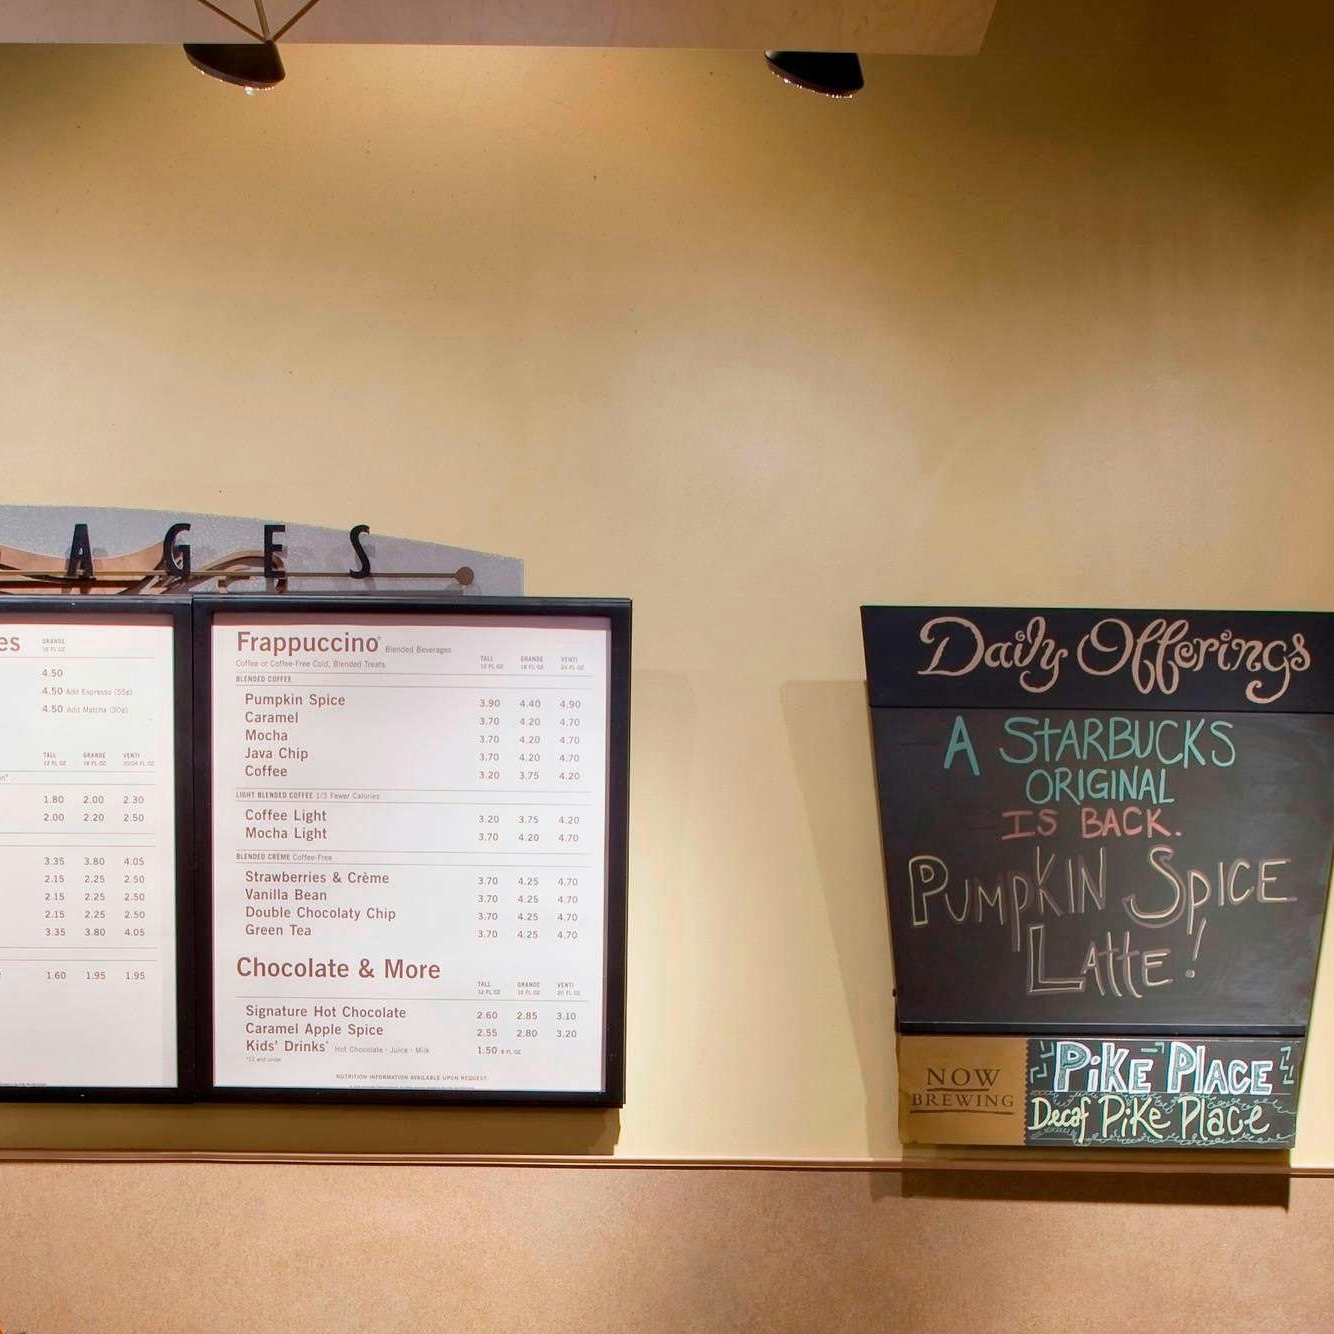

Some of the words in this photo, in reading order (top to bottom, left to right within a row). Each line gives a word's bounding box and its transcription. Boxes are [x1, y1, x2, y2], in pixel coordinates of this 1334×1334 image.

[917, 616, 1067, 693] Daily
[1077, 617, 1310, 703] Offerings
[42, 668, 63, 678] 4.50
[944, 717, 979, 775] A
[1026, 768, 1174, 804] ORIGINAL
[1001, 810, 1058, 840] IS
[1082, 808, 1181, 838] BACK.
[245, 871, 326, 884] Strawberries
[332, 871, 341, 884] &
[347, 871, 389, 884] Crème
[237, 956, 349, 978] Chocolate
[358, 959, 374, 978] &
[385, 959, 440, 979] More
[246, 1005, 308, 1020] Signature
[313, 1005, 336, 1018] Hot
[342, 1005, 406, 1019] Chocolate
[926, 1068, 999, 1088] NOW
[911, 1094, 1014, 1108] BREWING
[1029, 1097, 1088, 1138] Decaf
[1100, 1097, 1170, 1137] Pike
[1181, 1097, 1269, 1137] Place
